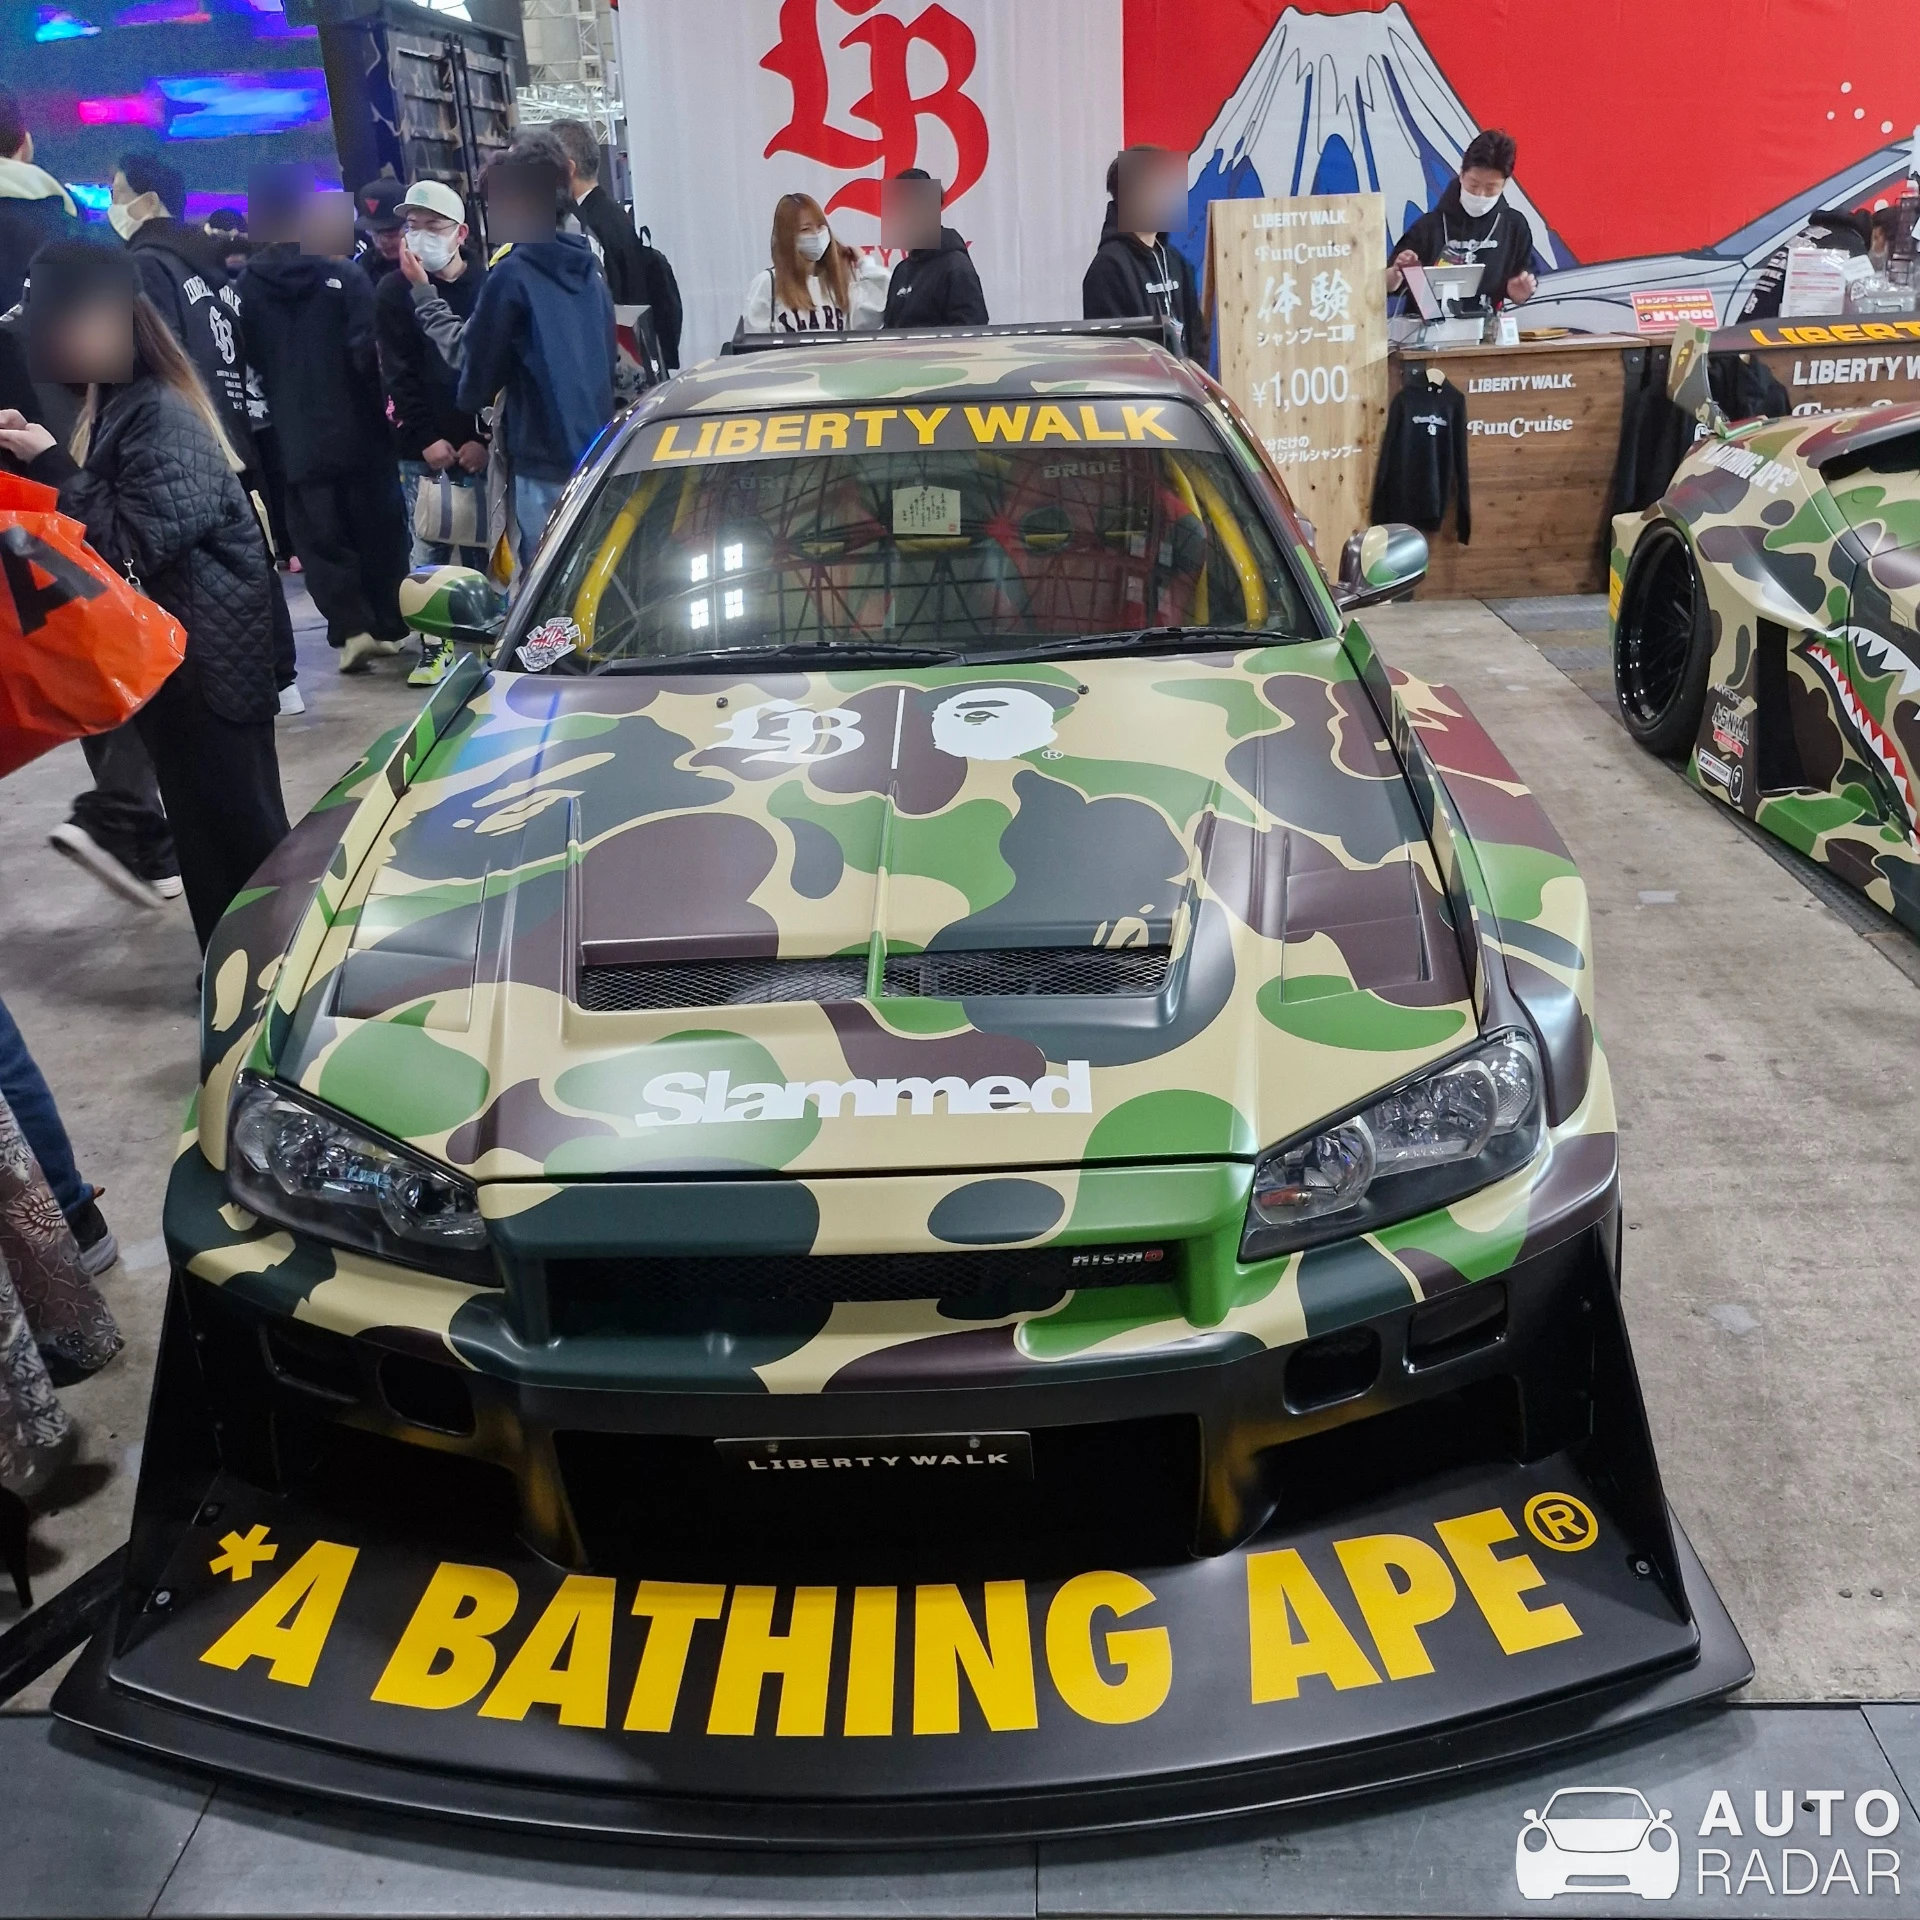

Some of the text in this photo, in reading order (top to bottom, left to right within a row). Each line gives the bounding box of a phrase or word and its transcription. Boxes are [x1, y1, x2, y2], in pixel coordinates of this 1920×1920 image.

[1253, 211, 1308, 228] LIBERTY
[1254, 240, 1352, 264] FunCruise
[1257, 268, 1353, 324] 体験
[1792, 355, 1904, 386] LIBERTY
[1251, 364, 1349, 412] ¥1,000
[1468, 375, 1530, 393] LIBERTY
[652, 405, 1179, 462] LIBERTY WALK
[1466, 414, 1574, 438] FunCruise
[1261, 435, 1310, 452] 分だけの
[1042, 459, 1123, 478] BRIDE
[634, 1059, 1093, 1128] Slammed
[748, 1453, 1009, 1470] LIBERTY WALK
[370, 1561, 1173, 1736] BATHING
